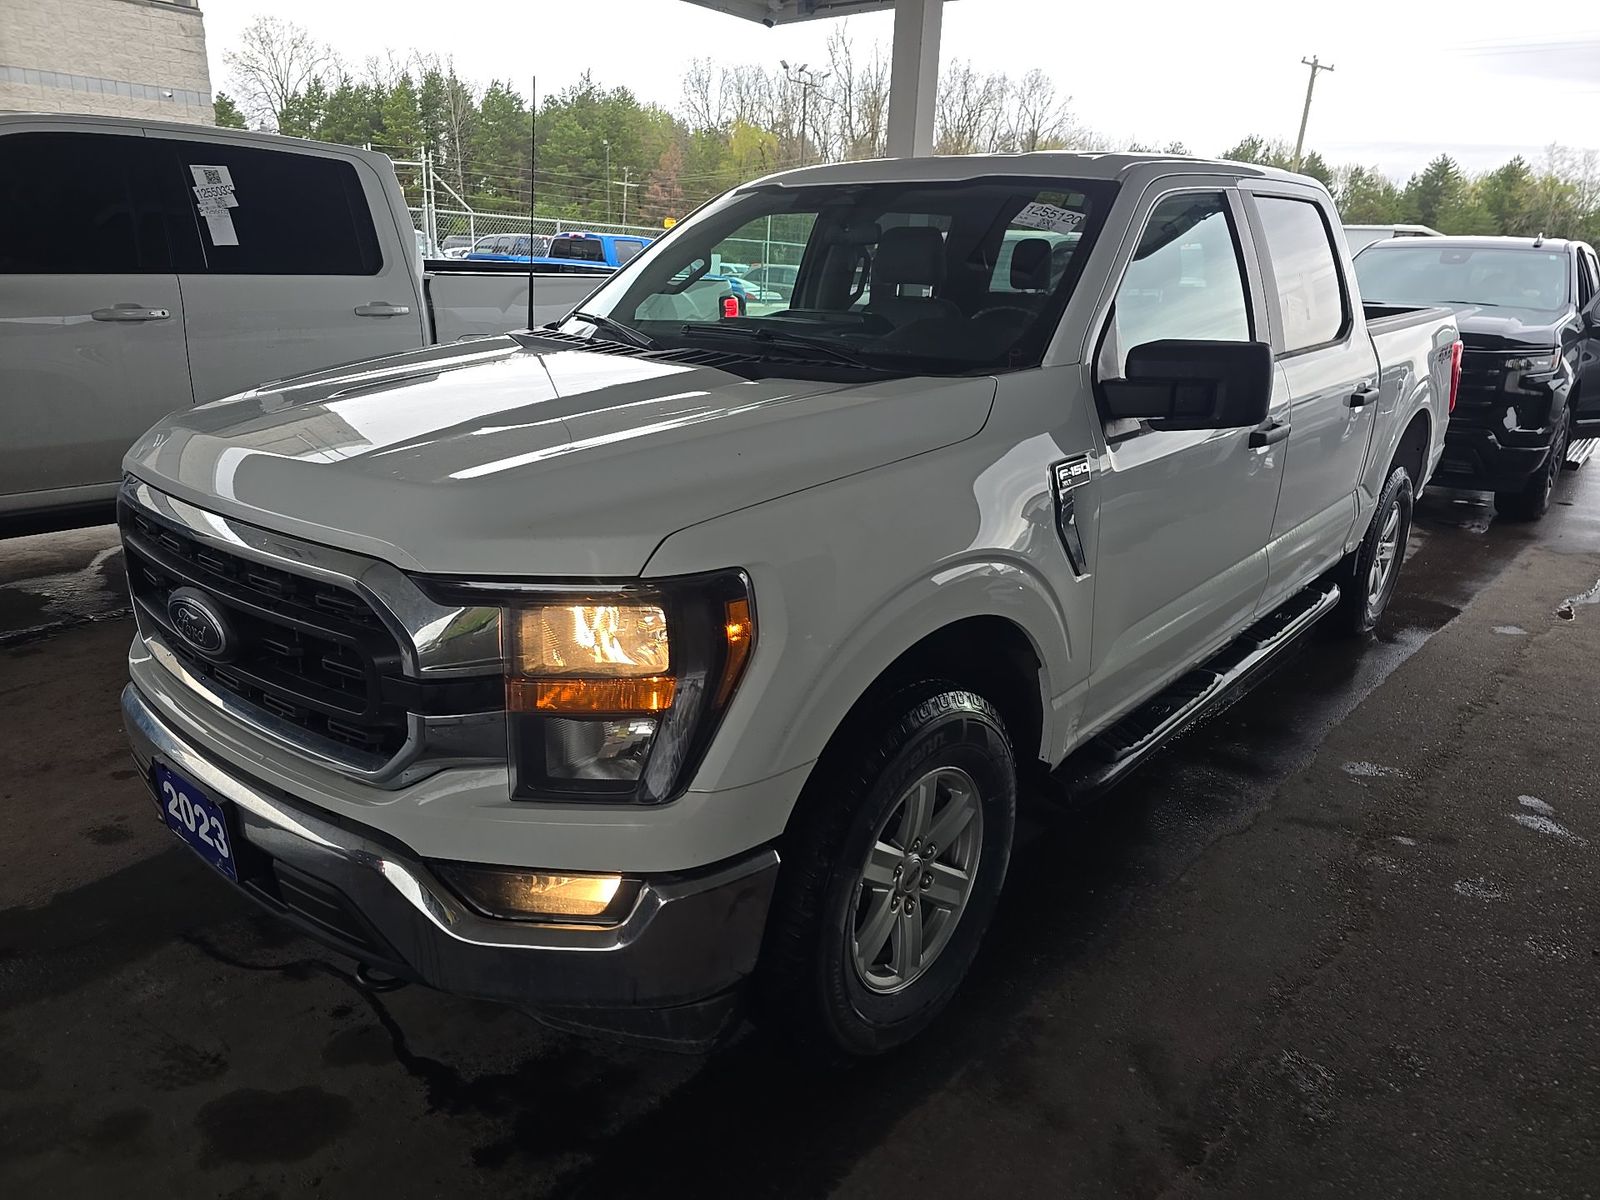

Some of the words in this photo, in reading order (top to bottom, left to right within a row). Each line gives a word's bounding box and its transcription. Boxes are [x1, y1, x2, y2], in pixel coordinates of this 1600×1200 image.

[1026, 204, 1082, 225] 1255120
[1060, 462, 1090, 480] F-150
[176, 607, 207, 645] Ford
[163, 780, 229, 858] 2023
